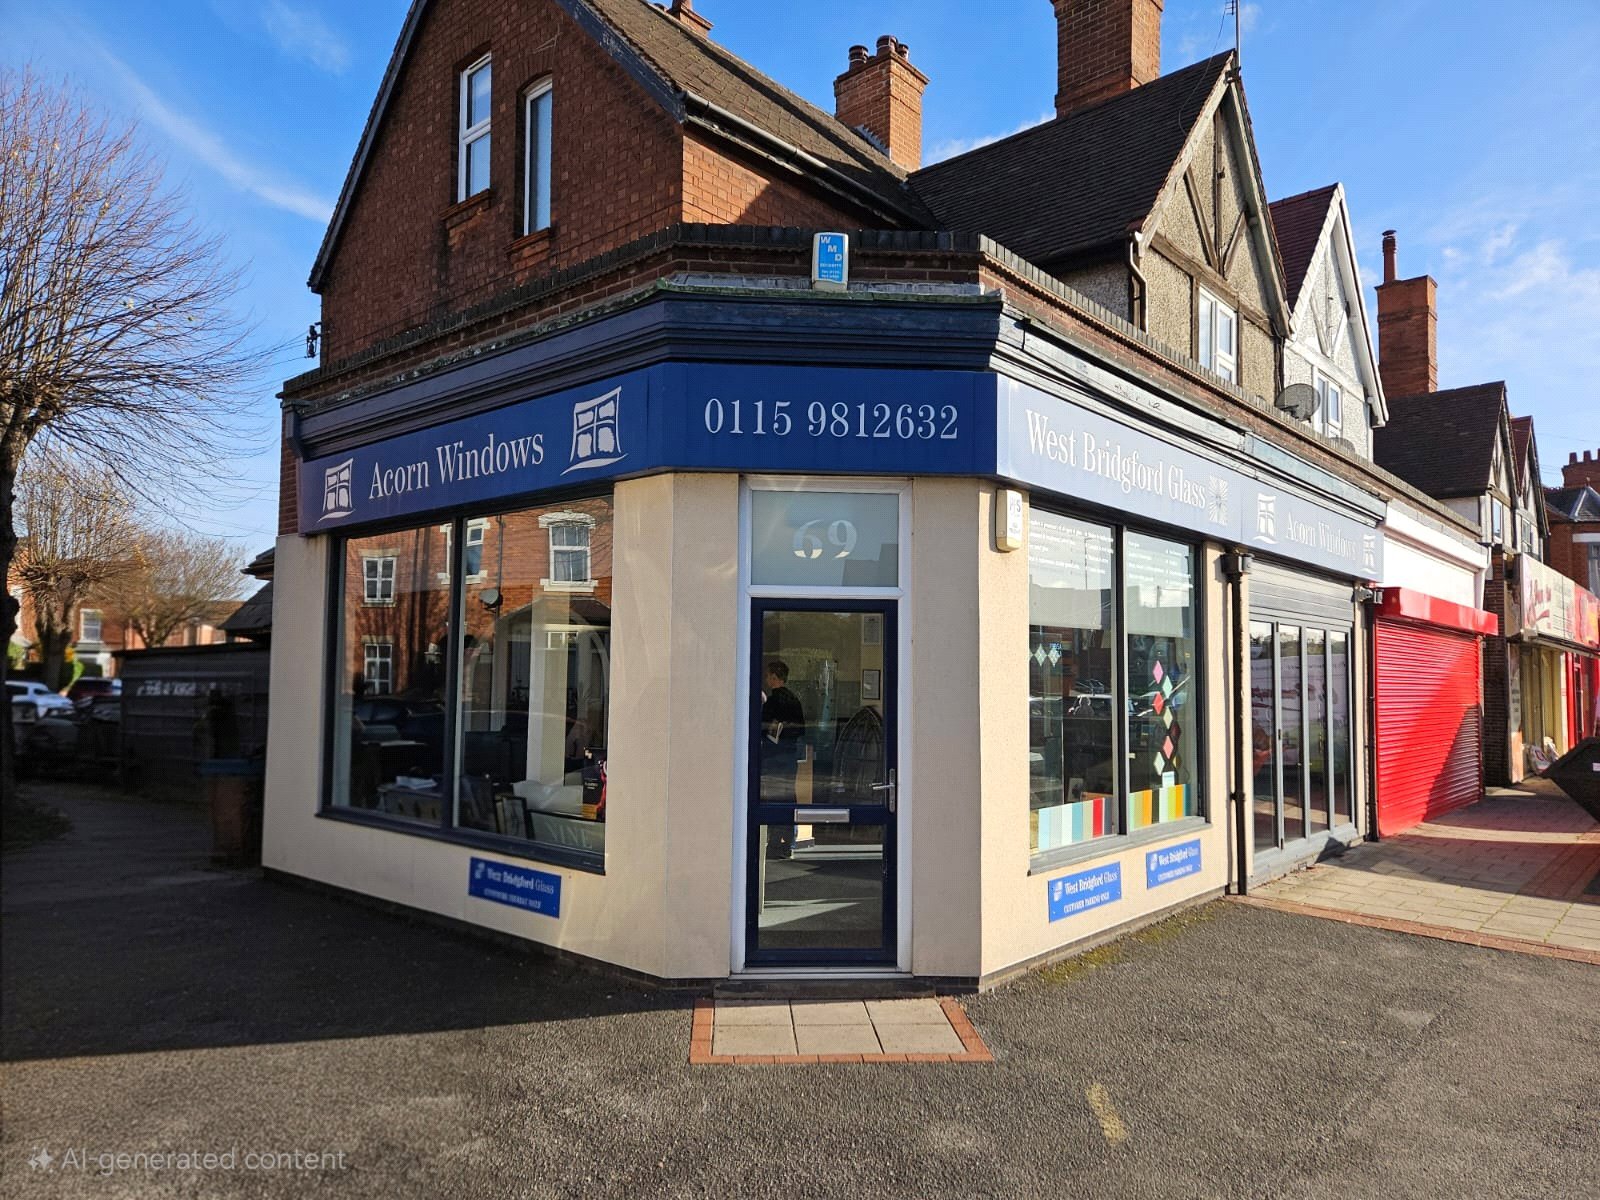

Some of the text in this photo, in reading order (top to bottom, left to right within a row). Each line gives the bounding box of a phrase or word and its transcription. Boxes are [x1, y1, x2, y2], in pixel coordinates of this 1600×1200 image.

[704, 398, 958, 440] 0115 9812632
[368, 433, 544, 500] Acorn Windows
[1026, 409, 1206, 509] West Bridgford Glass
[793, 519, 857, 559] 69
[1286, 512, 1316, 547] Acorn
